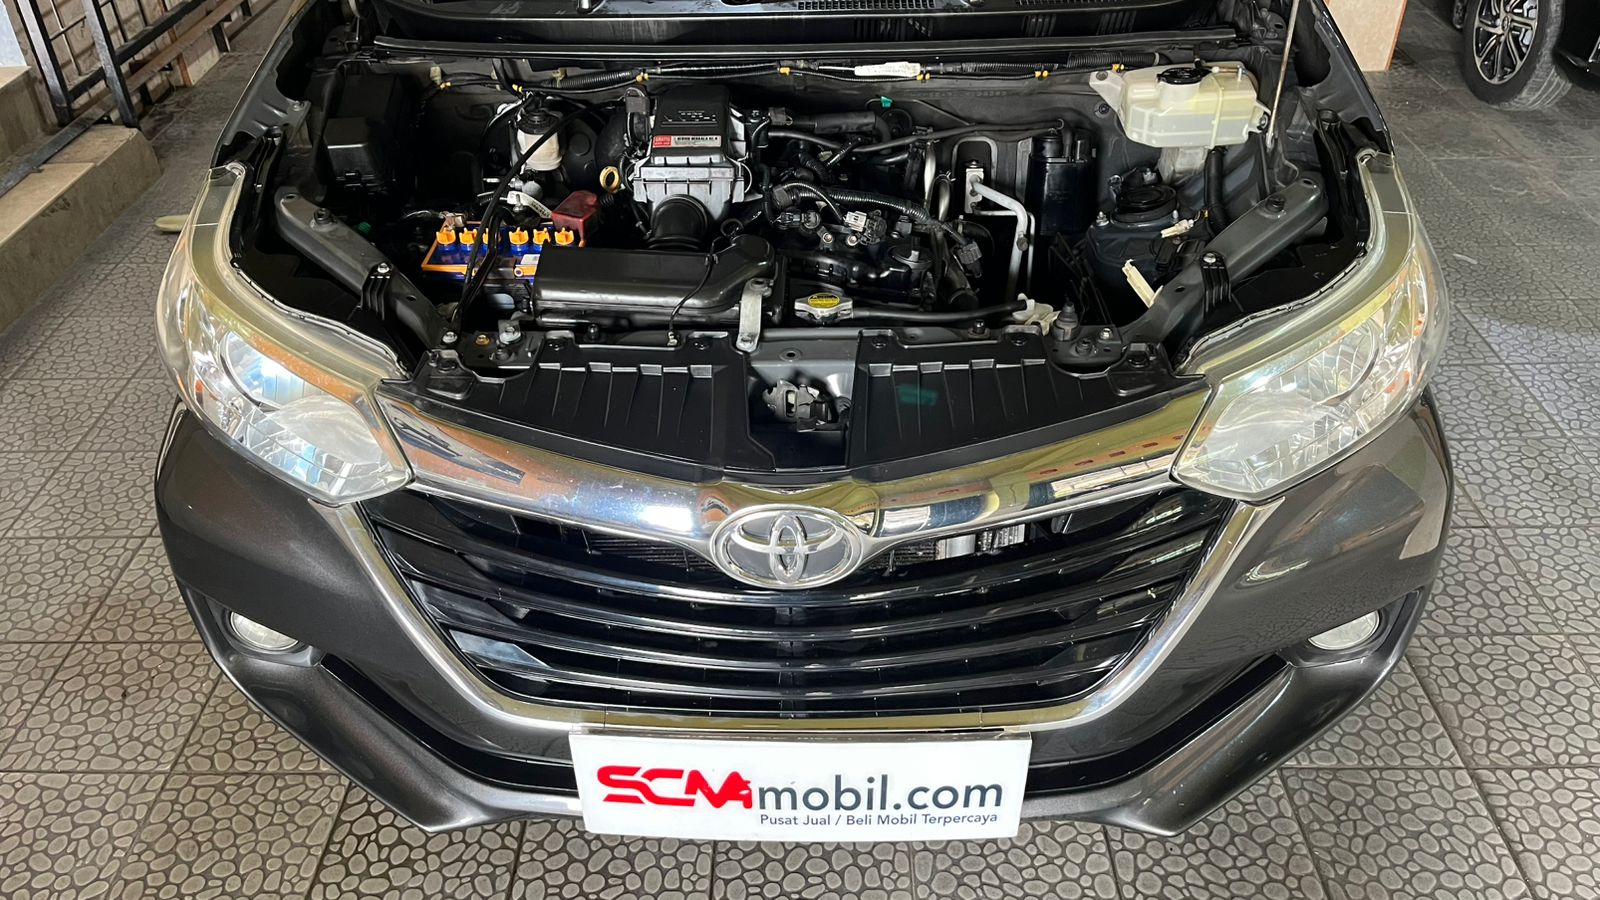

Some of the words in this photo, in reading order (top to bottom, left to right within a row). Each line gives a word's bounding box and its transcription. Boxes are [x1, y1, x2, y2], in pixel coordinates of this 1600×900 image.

[760, 814, 798, 825] Pusat
[802, 814, 831, 825] Jual
[834, 814, 842, 826] /
[846, 814, 872, 825] Beli
[877, 813, 917, 825] Mobil
[921, 813, 998, 826] Terpercaya
